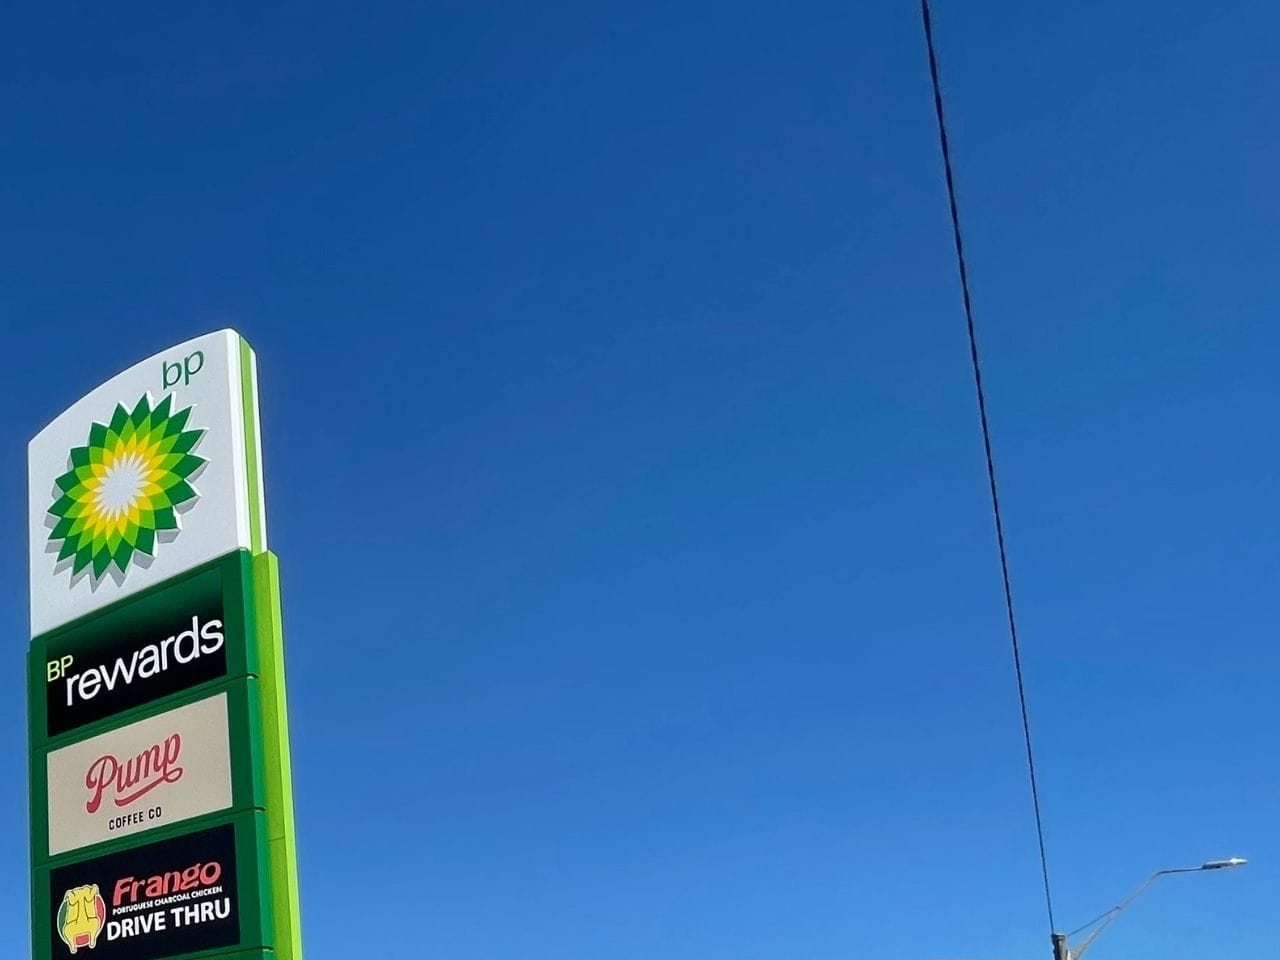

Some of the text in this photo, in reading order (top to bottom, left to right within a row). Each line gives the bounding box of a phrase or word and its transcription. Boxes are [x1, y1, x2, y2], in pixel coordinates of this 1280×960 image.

[163, 351, 204, 390] bp
[47, 655, 73, 682] BP
[66, 616, 224, 706] rewards
[85, 732, 184, 813] Pump
[108, 806, 162, 831] COFFEE CO
[112, 885, 223, 915] PORTUGUESE CHARCOAL CHICKEN
[113, 861, 221, 906] Frango
[106, 897, 231, 941] DRIVE THRU
